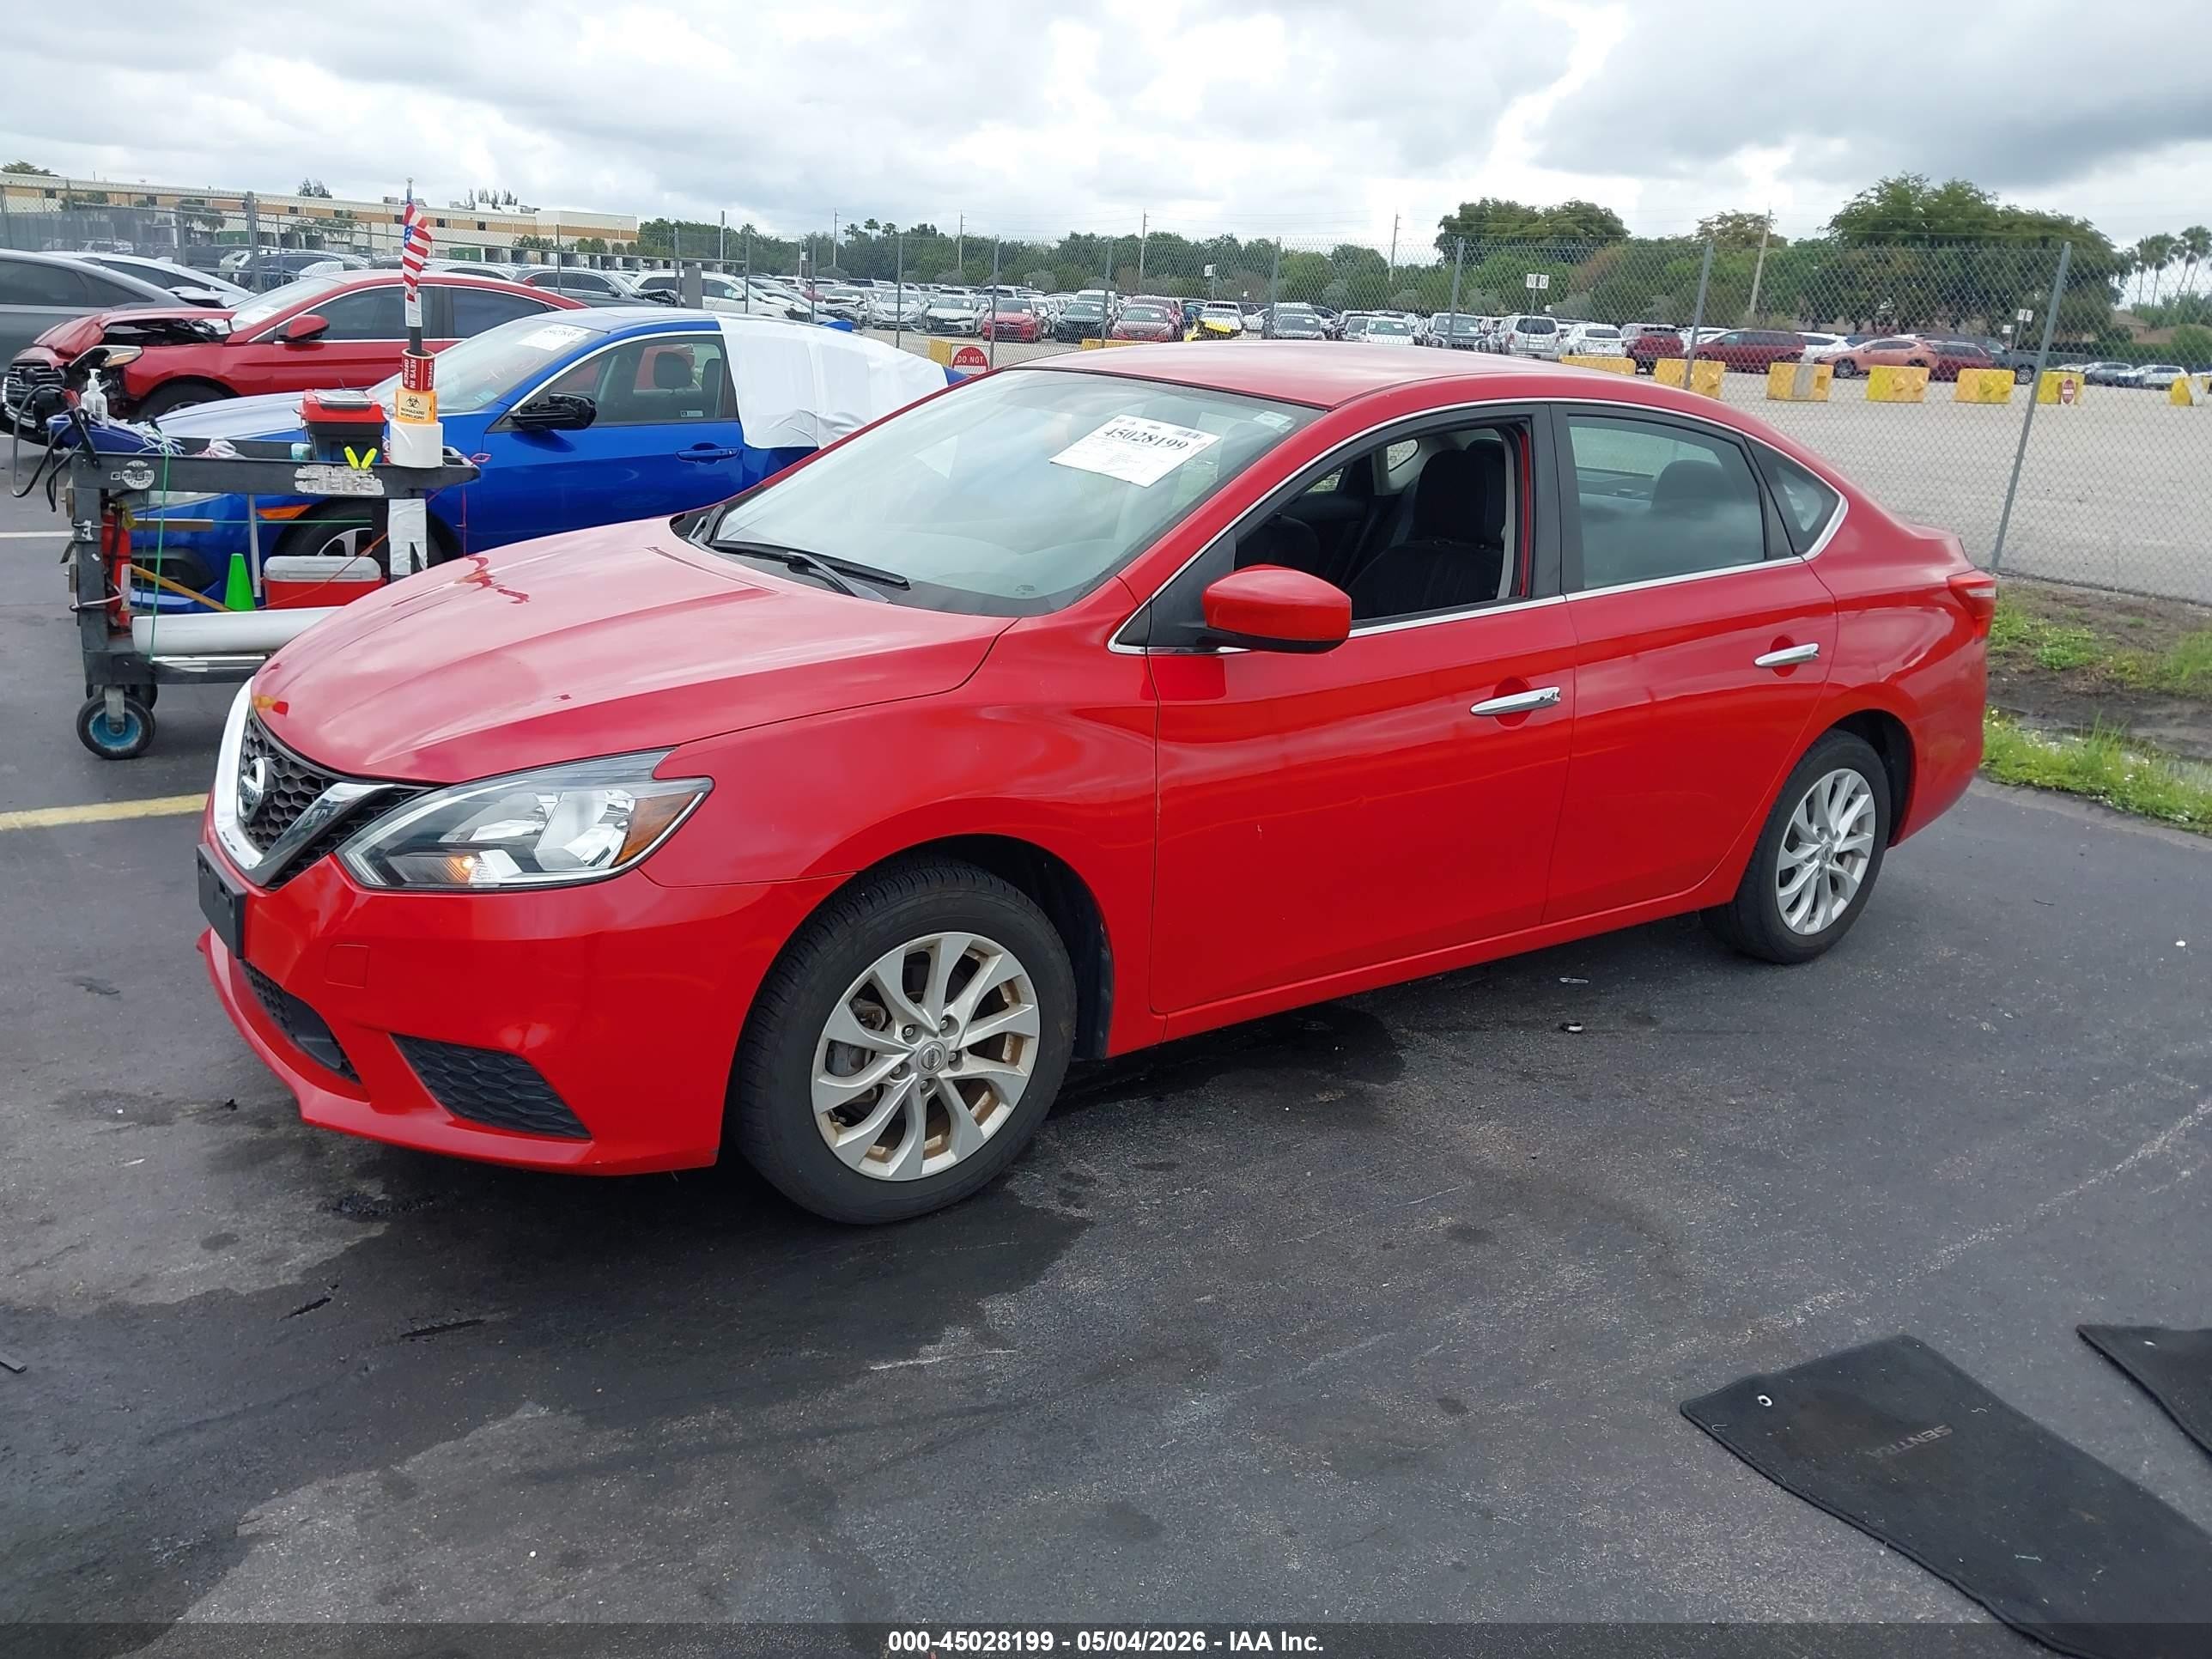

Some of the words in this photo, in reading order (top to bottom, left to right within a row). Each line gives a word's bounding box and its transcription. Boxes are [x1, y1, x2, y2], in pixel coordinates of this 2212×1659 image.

[957, 356, 968, 364] DO
[969, 356, 985, 364] NOT
[410, 380, 416, 389] IN
[1103, 428, 1189, 451] 45028199
